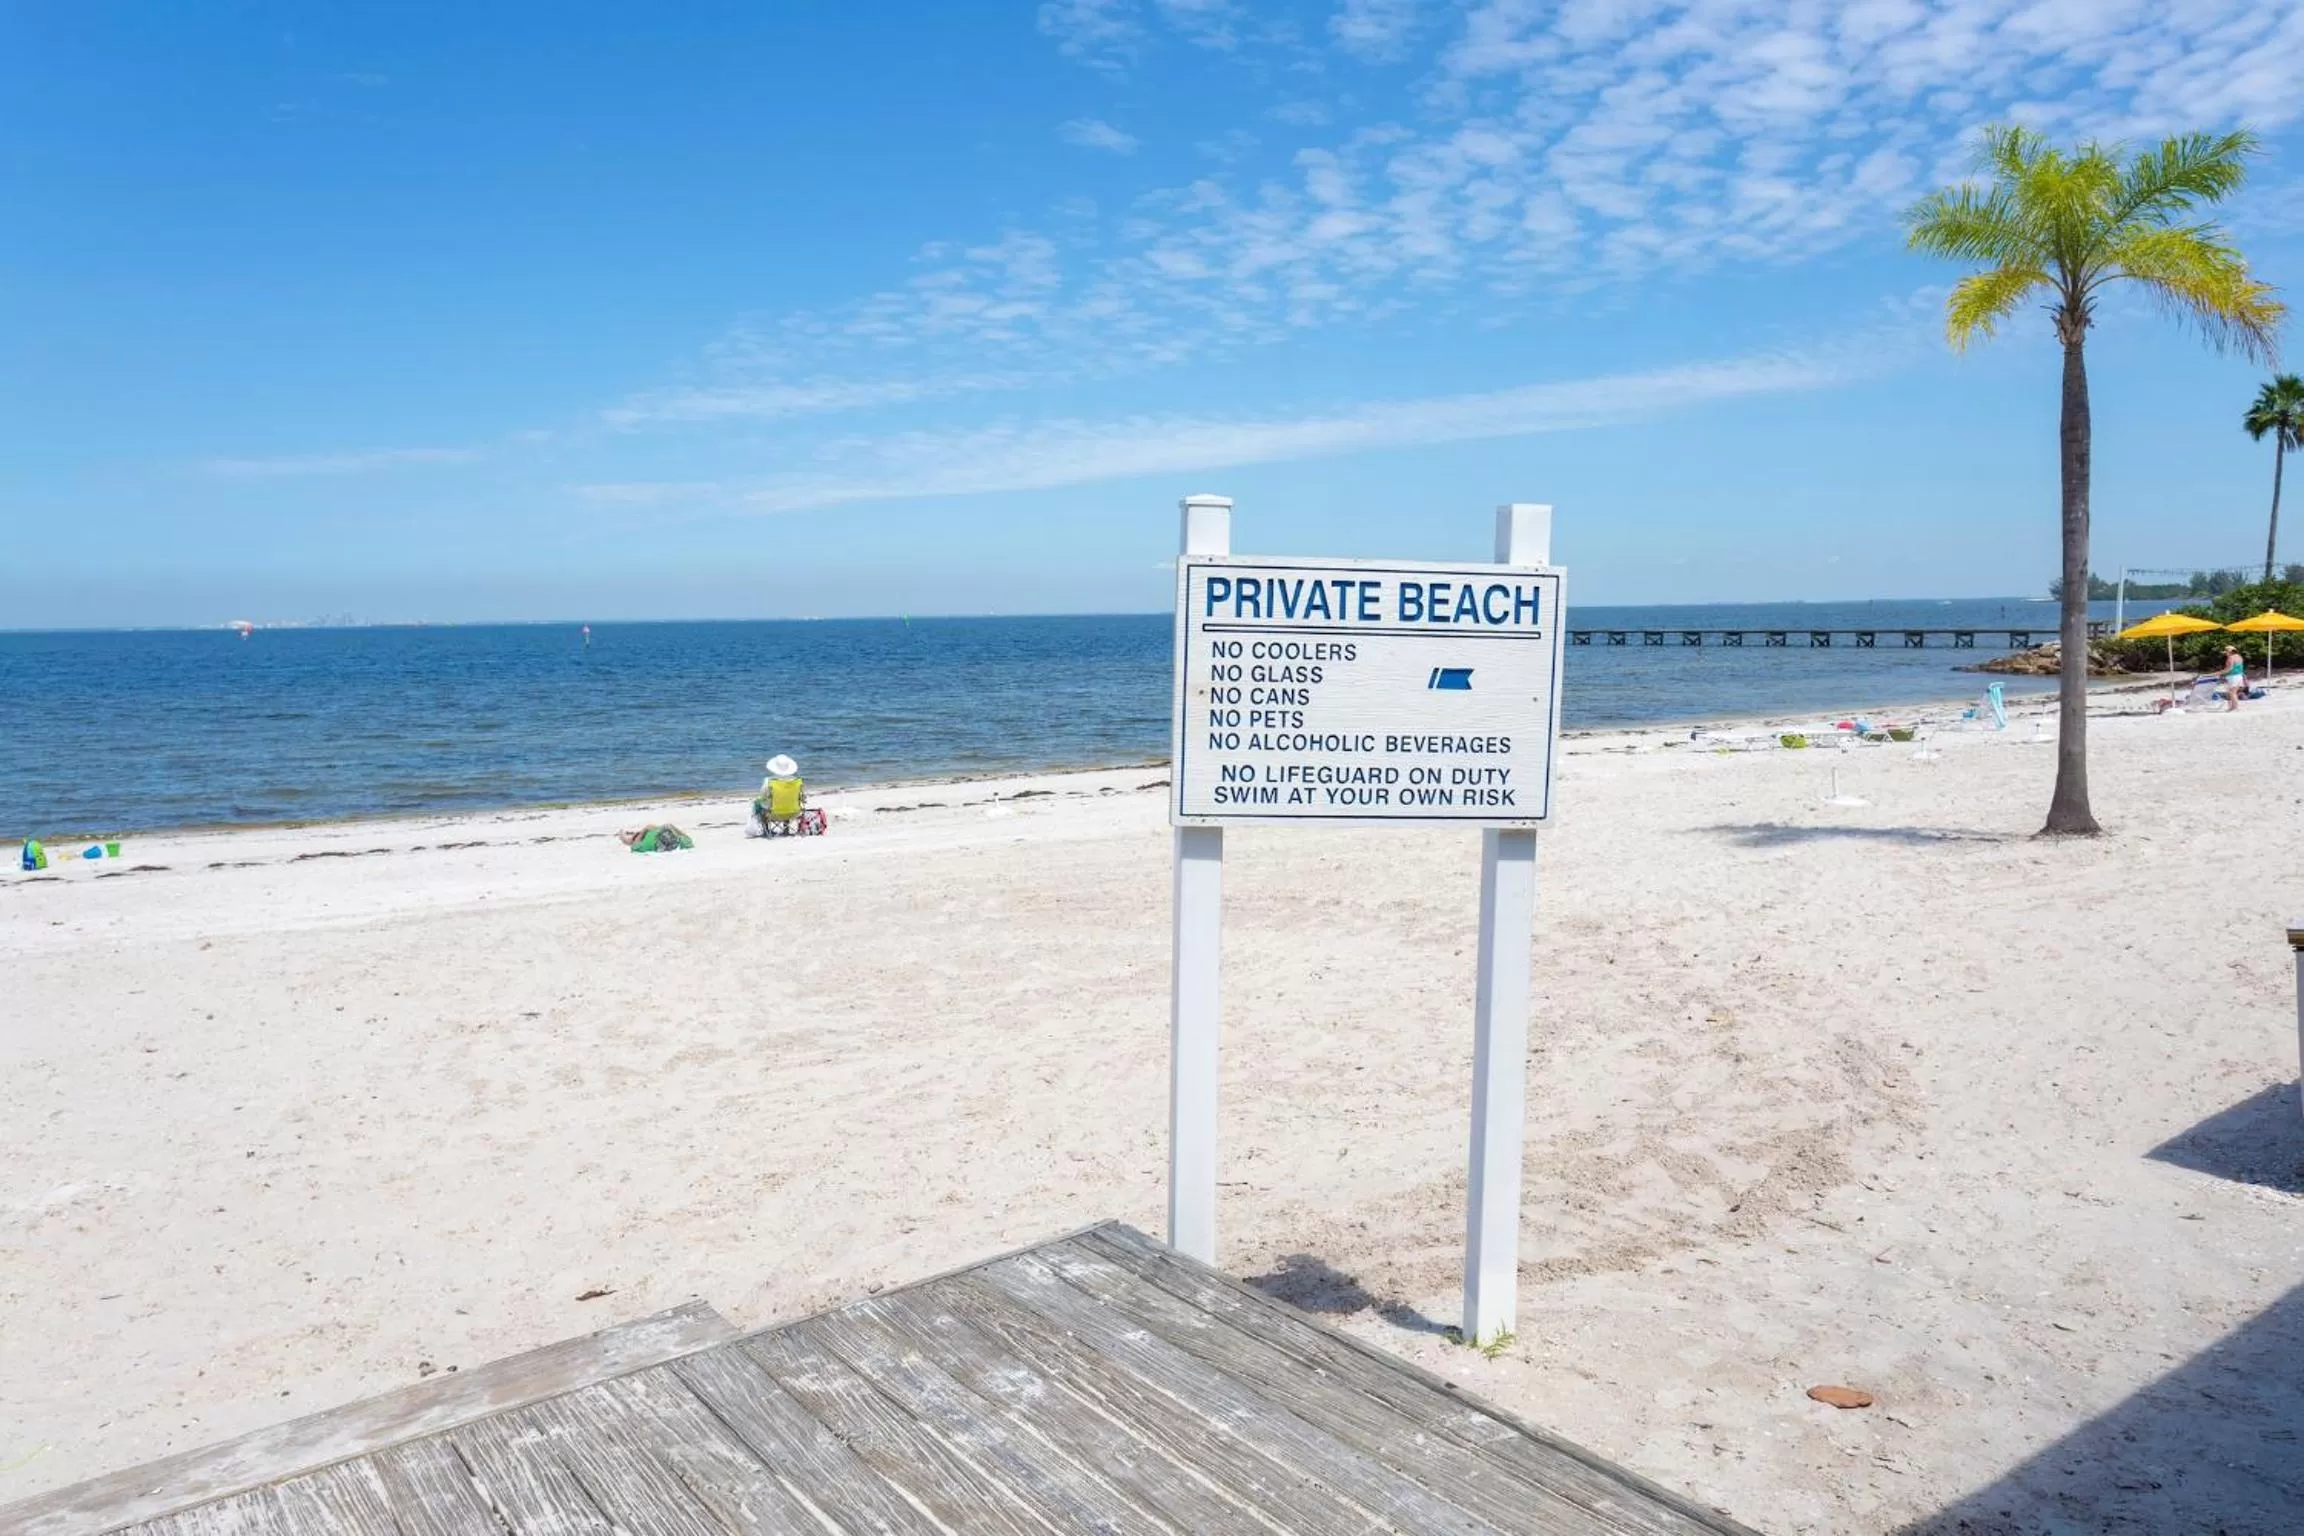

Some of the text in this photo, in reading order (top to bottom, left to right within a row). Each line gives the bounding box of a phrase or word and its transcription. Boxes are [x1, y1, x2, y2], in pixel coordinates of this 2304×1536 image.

[1206, 577, 1540, 625] PRIVATE BEACH
[1213, 641, 1356, 661] NO COOLERS
[1212, 665, 1323, 684] NO GLASS
[1211, 687, 1309, 705] NO CANS
[1210, 709, 1303, 728] NO PETS
[1210, 733, 1510, 753] NO ALCOHOLIC BEVERAGES
[1222, 765, 1510, 785] NO LIFEGUARD ON DUTY
[1214, 786, 1515, 805] SWIM AT YOUR OWN RISK
